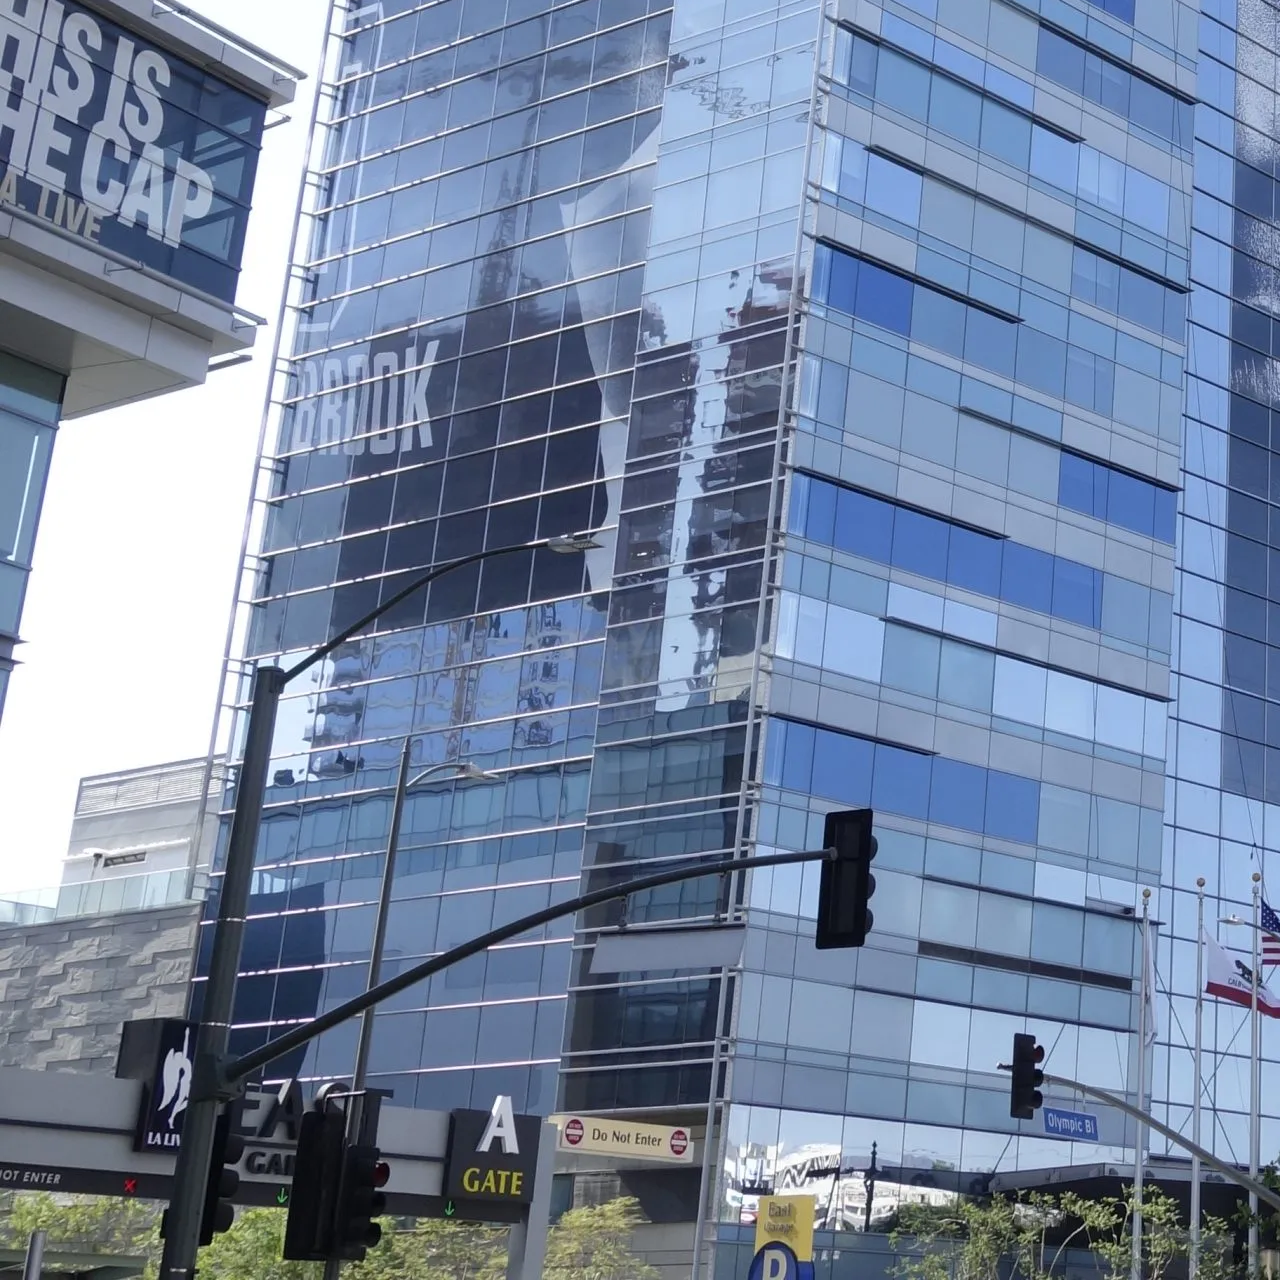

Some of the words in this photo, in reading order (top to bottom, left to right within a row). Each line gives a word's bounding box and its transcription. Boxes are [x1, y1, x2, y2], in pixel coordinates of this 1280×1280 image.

[103, 35, 171, 143] IS
[81, 120, 214, 249] CAP
[37, 187, 103, 243] LIVE
[475, 1094, 520, 1155] A
[1047, 1112, 1083, 1134] Olympic
[147, 1131, 162, 1145] LA
[592, 1128, 608, 1141] Do
[612, 1130, 631, 1144] Not
[635, 1132, 662, 1147] Enter
[23, 1171, 61, 1184] ENTER
[463, 1167, 523, 1195] GATE
